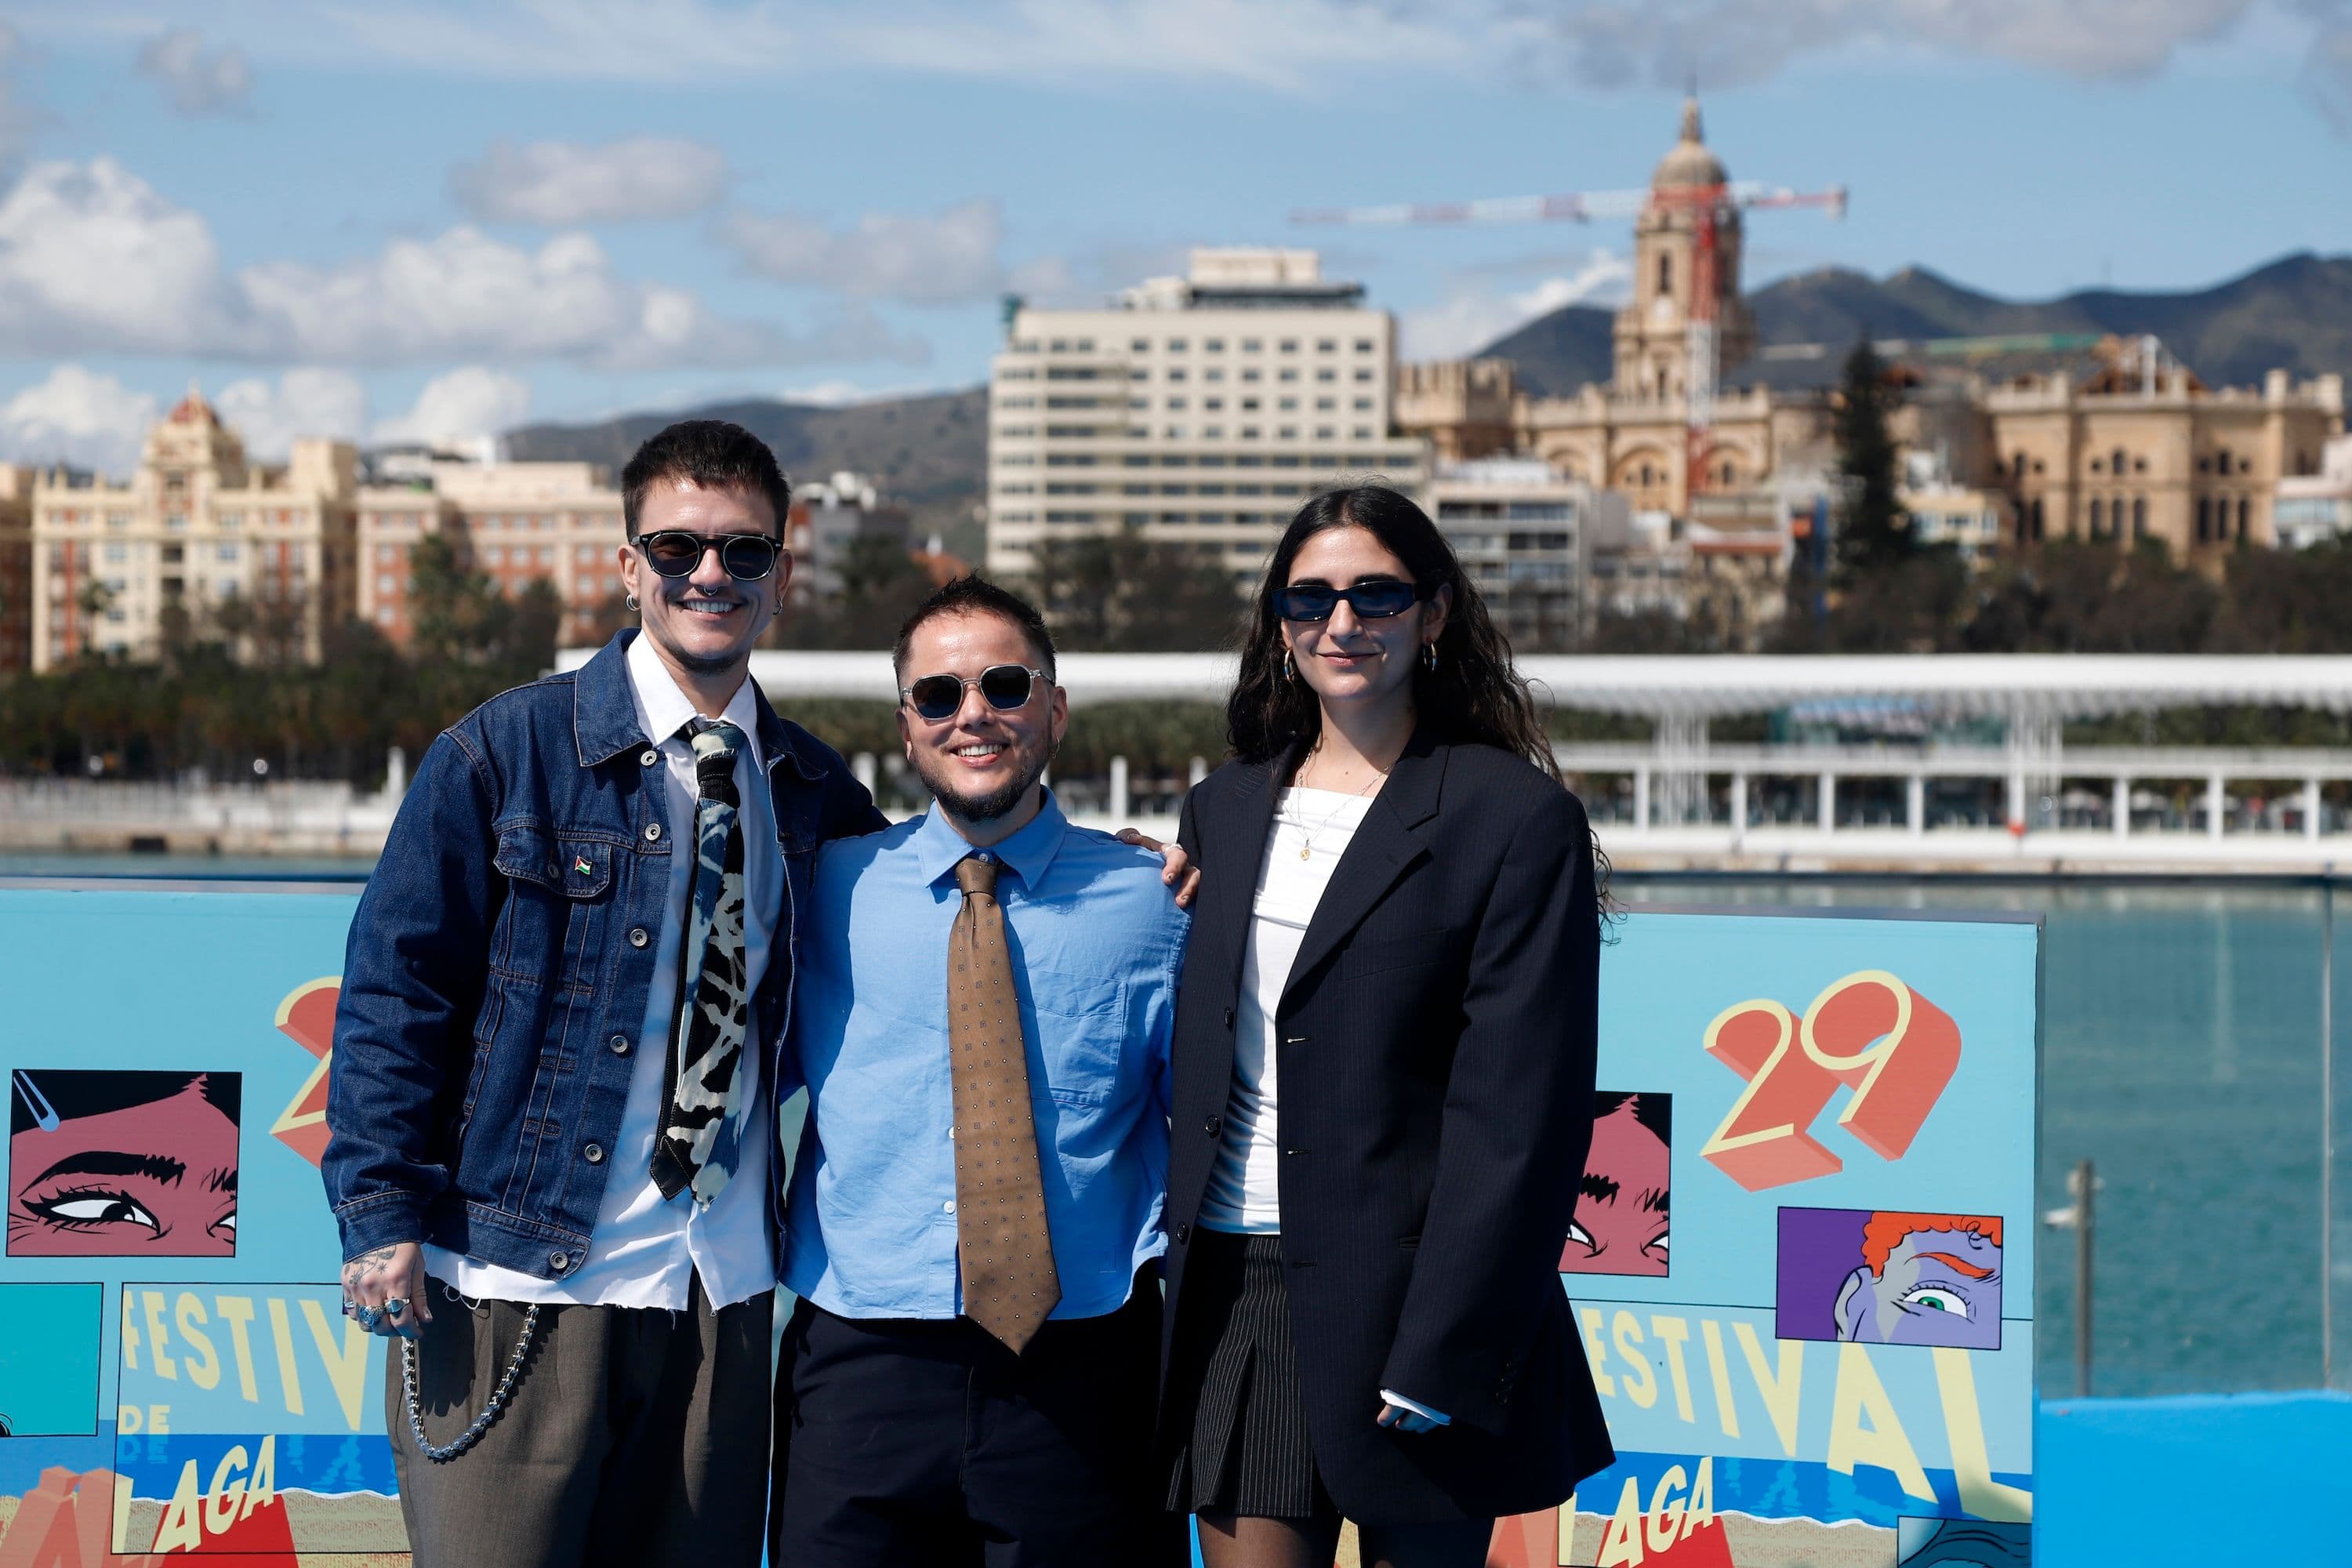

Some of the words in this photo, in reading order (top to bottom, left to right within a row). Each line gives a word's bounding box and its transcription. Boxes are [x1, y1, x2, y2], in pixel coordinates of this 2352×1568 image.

[270, 975, 343, 1171] 2
[1700, 969, 1963, 1192] 29
[118, 1404, 171, 1436] DE
[122, 1290, 370, 1432] FESTIV
[1580, 1308, 2033, 1523] ESTIVAL
